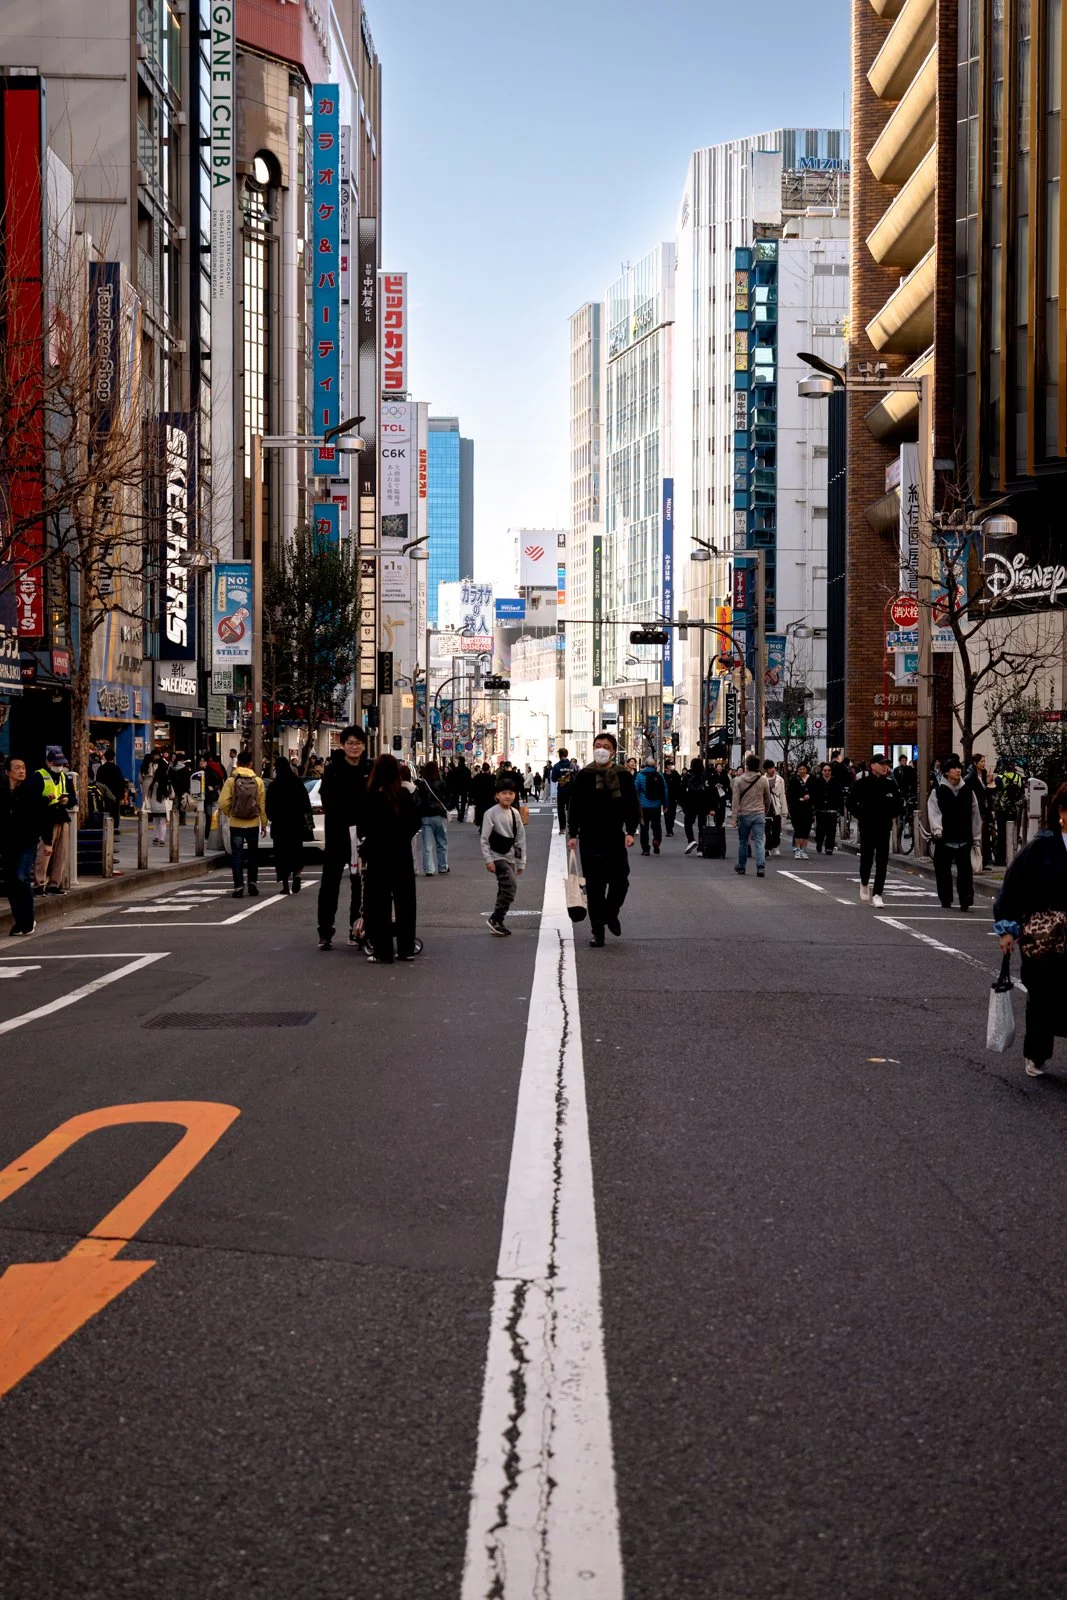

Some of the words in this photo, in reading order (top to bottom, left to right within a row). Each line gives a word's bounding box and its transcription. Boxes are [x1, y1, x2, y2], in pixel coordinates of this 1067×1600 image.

[212, 0, 232, 81] GANE
[212, 95, 232, 188] ICHIBA
[800, 156, 850, 170] MIZUH
[97, 283, 114, 317] Tax
[97, 318, 114, 357] Free
[384, 275, 403, 389] ビックカメラ
[97, 359, 114, 402] Shop
[382, 424, 405, 432] TCL
[382, 448, 406, 458] C6K
[166, 424, 188, 647] SKECHERS
[227, 576, 248, 585] NO!
[461, 584, 493, 607] カラオケ
[894, 606, 918, 618] 消火栓
[464, 615, 489, 635] 鉄人
[171, 663, 186, 678] 靴
[159, 677, 197, 696] SKECHERS
[873, 694, 917, 705] 紀伊國
